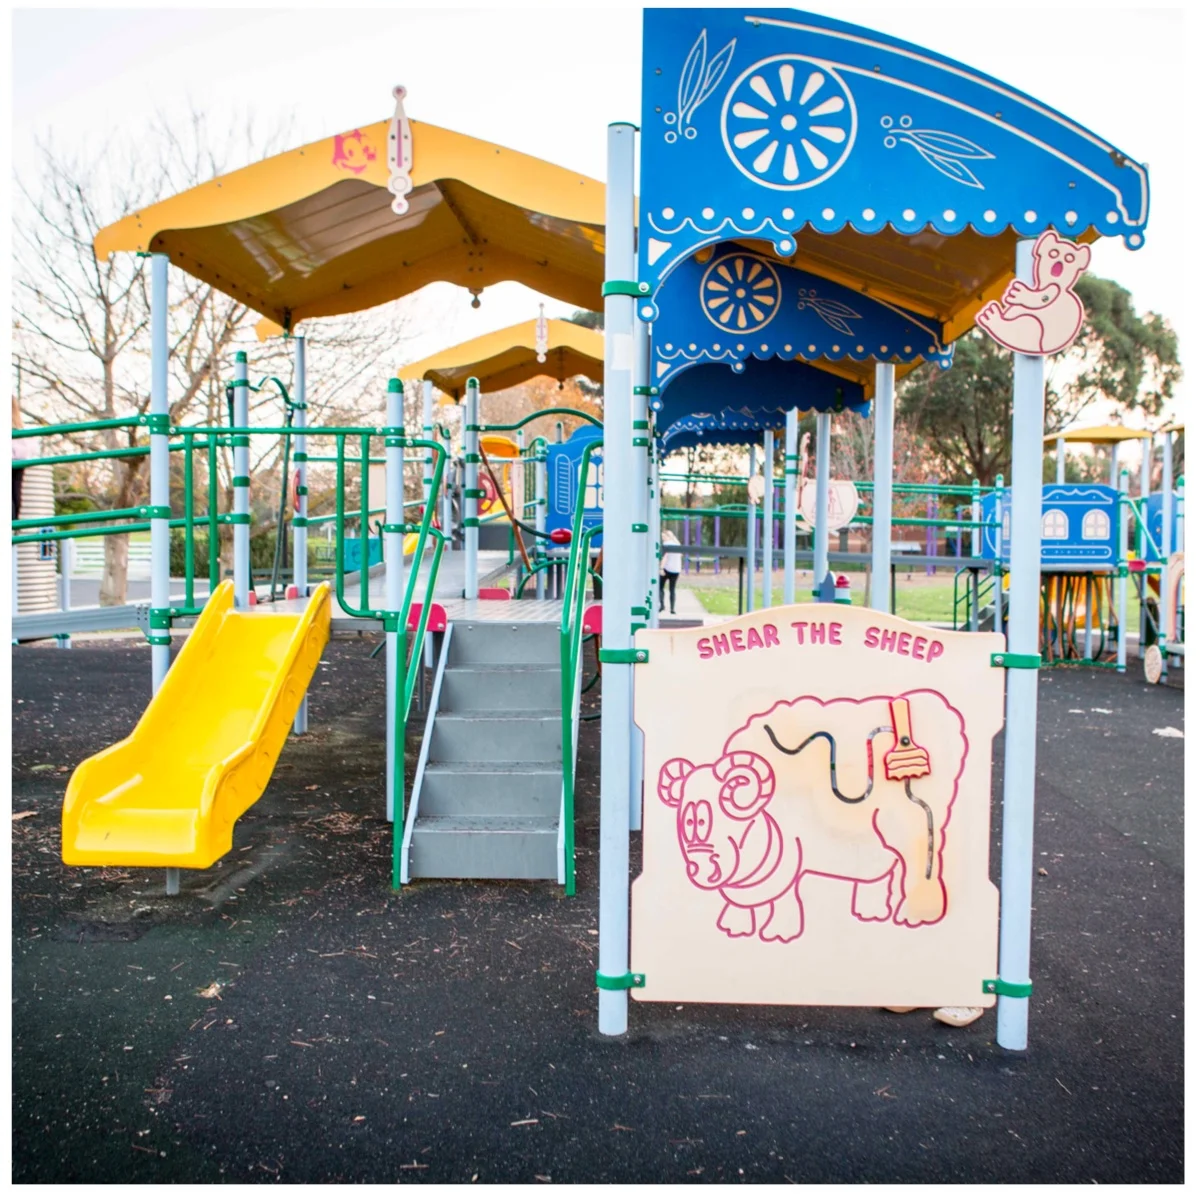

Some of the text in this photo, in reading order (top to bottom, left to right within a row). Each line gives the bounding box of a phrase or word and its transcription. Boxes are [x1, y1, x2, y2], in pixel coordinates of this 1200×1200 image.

[696, 621, 944, 663] SHEAR THE SHEEP
